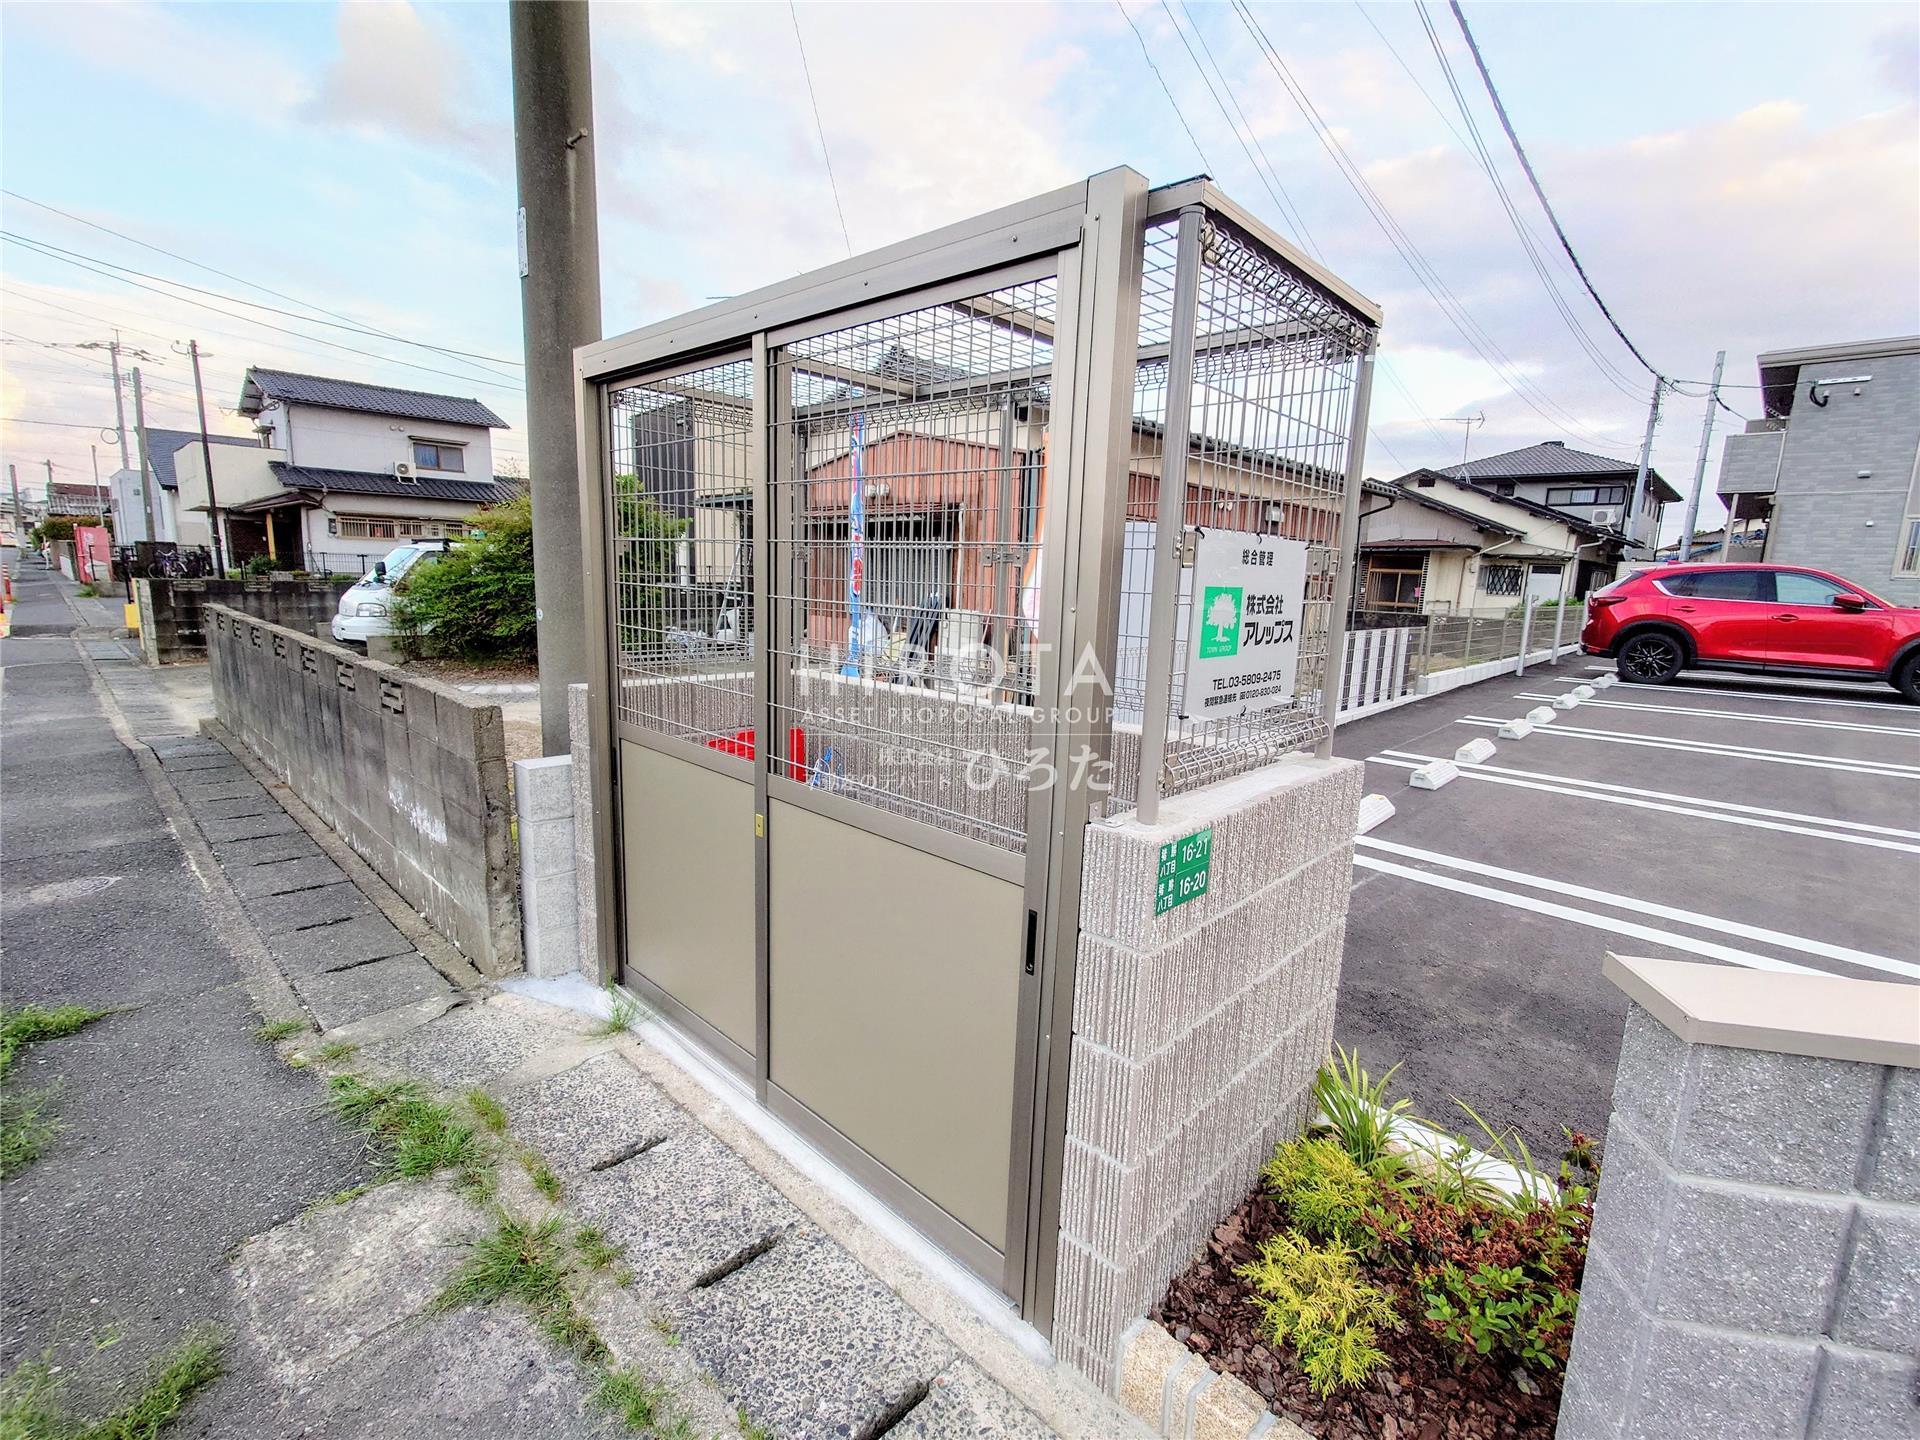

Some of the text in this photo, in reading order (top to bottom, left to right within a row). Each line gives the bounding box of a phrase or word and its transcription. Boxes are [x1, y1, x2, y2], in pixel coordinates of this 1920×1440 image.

[1242, 549, 1274, 566] 総合管理
[1246, 594, 1284, 616] 株式会社
[1243, 619, 1294, 647] アレップス
[1212, 670, 1281, 691] TEL.03-5809-2475
[1182, 837, 1208, 864] 16-21
[1160, 859, 1176, 877] 八丁目
[1179, 870, 1206, 897] 16-20
[1157, 893, 1173, 913] 八丁目
